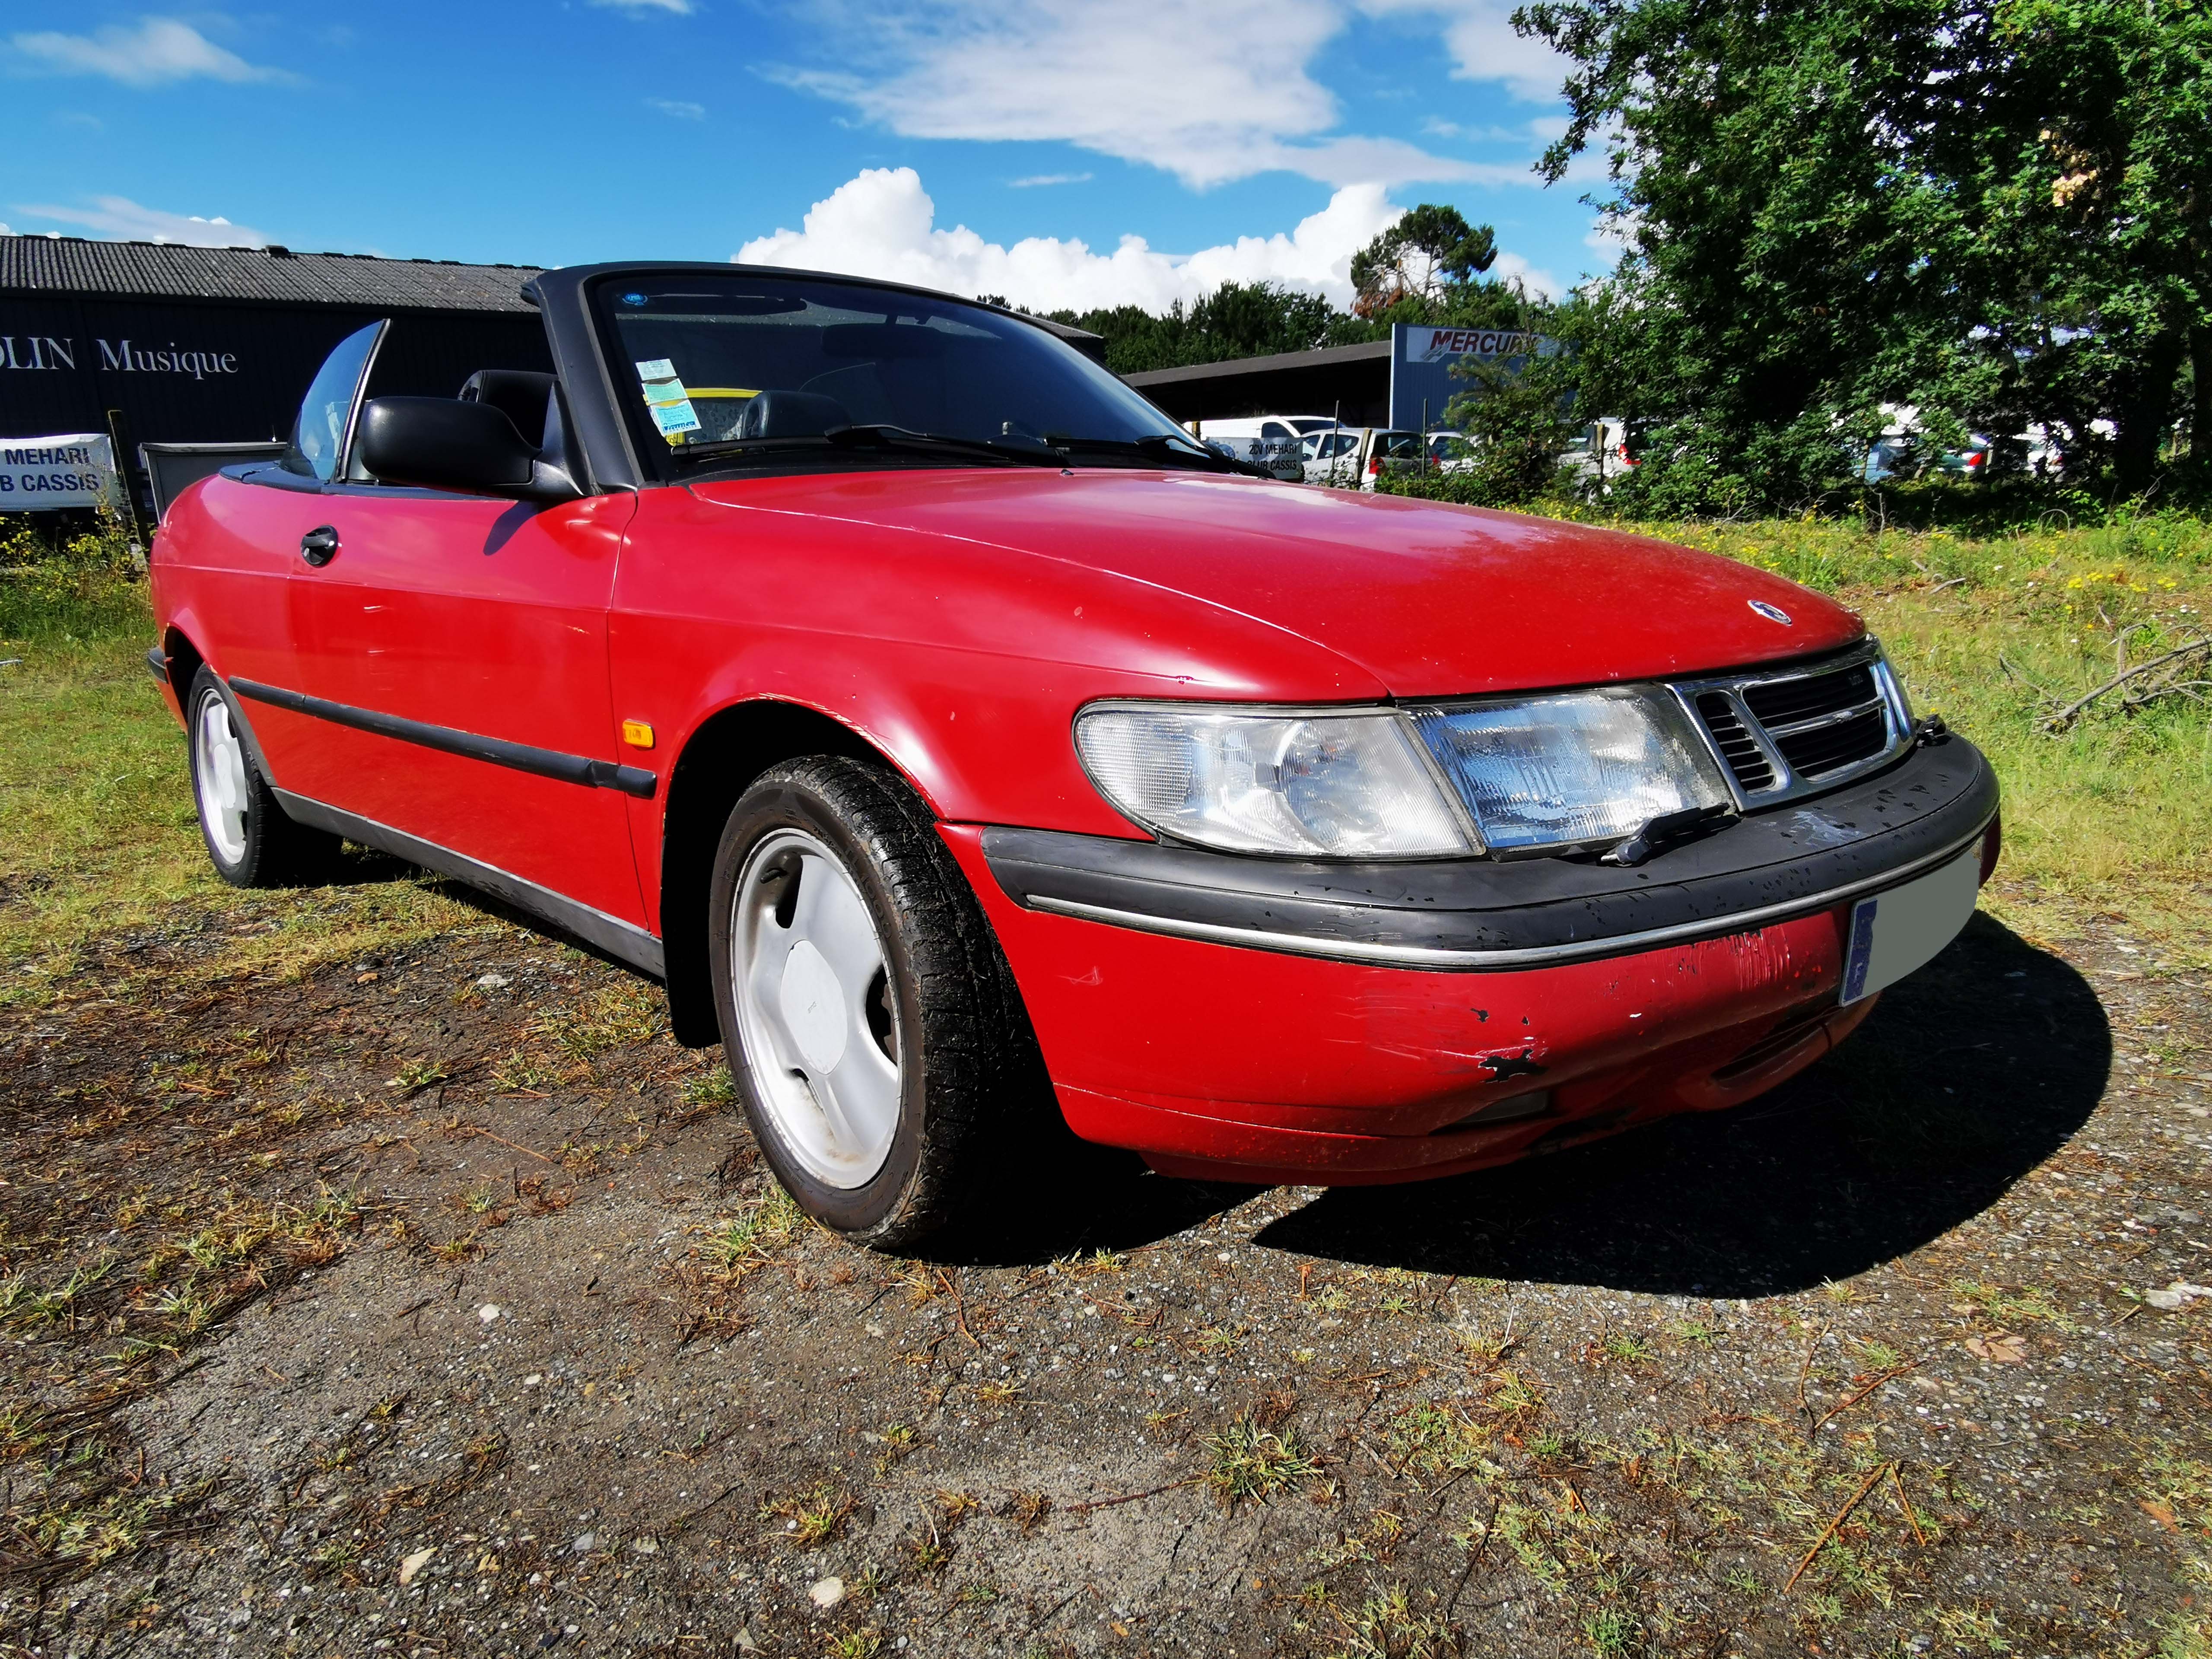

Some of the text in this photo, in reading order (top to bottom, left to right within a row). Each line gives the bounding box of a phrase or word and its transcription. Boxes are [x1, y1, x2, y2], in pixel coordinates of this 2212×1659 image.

[0, 337, 238, 380] LIN Musique
[5, 448, 91, 465] MEHARI
[1249, 444, 1297, 455] 2CV MEHARI
[1270, 460, 1297, 470] CASSIS
[22, 474, 99, 491] CASSIS
